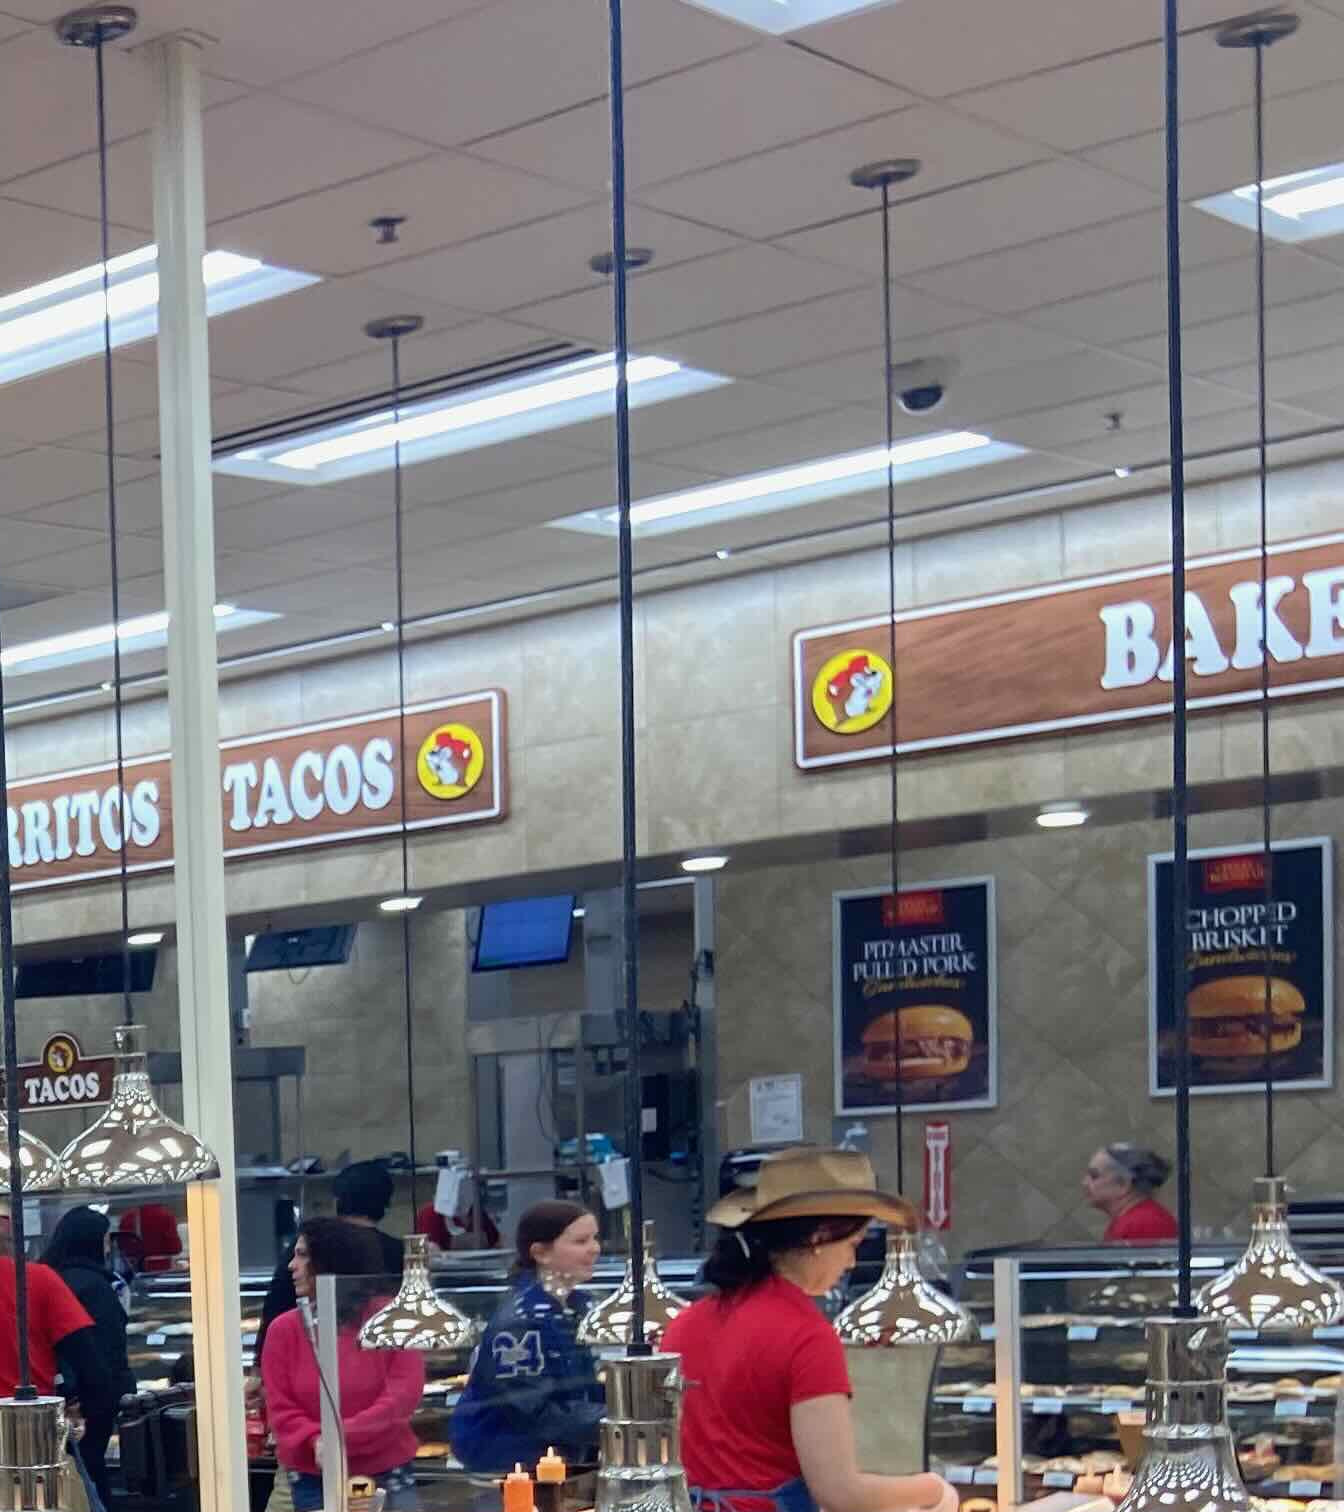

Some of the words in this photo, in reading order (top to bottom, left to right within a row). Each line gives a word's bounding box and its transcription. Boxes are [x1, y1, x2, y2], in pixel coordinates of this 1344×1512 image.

[222, 737, 394, 832] TACOS
[853, 957, 917, 983] PULLD
[923, 952, 977, 975] PORK
[24, 1071, 101, 1104] TACOS
